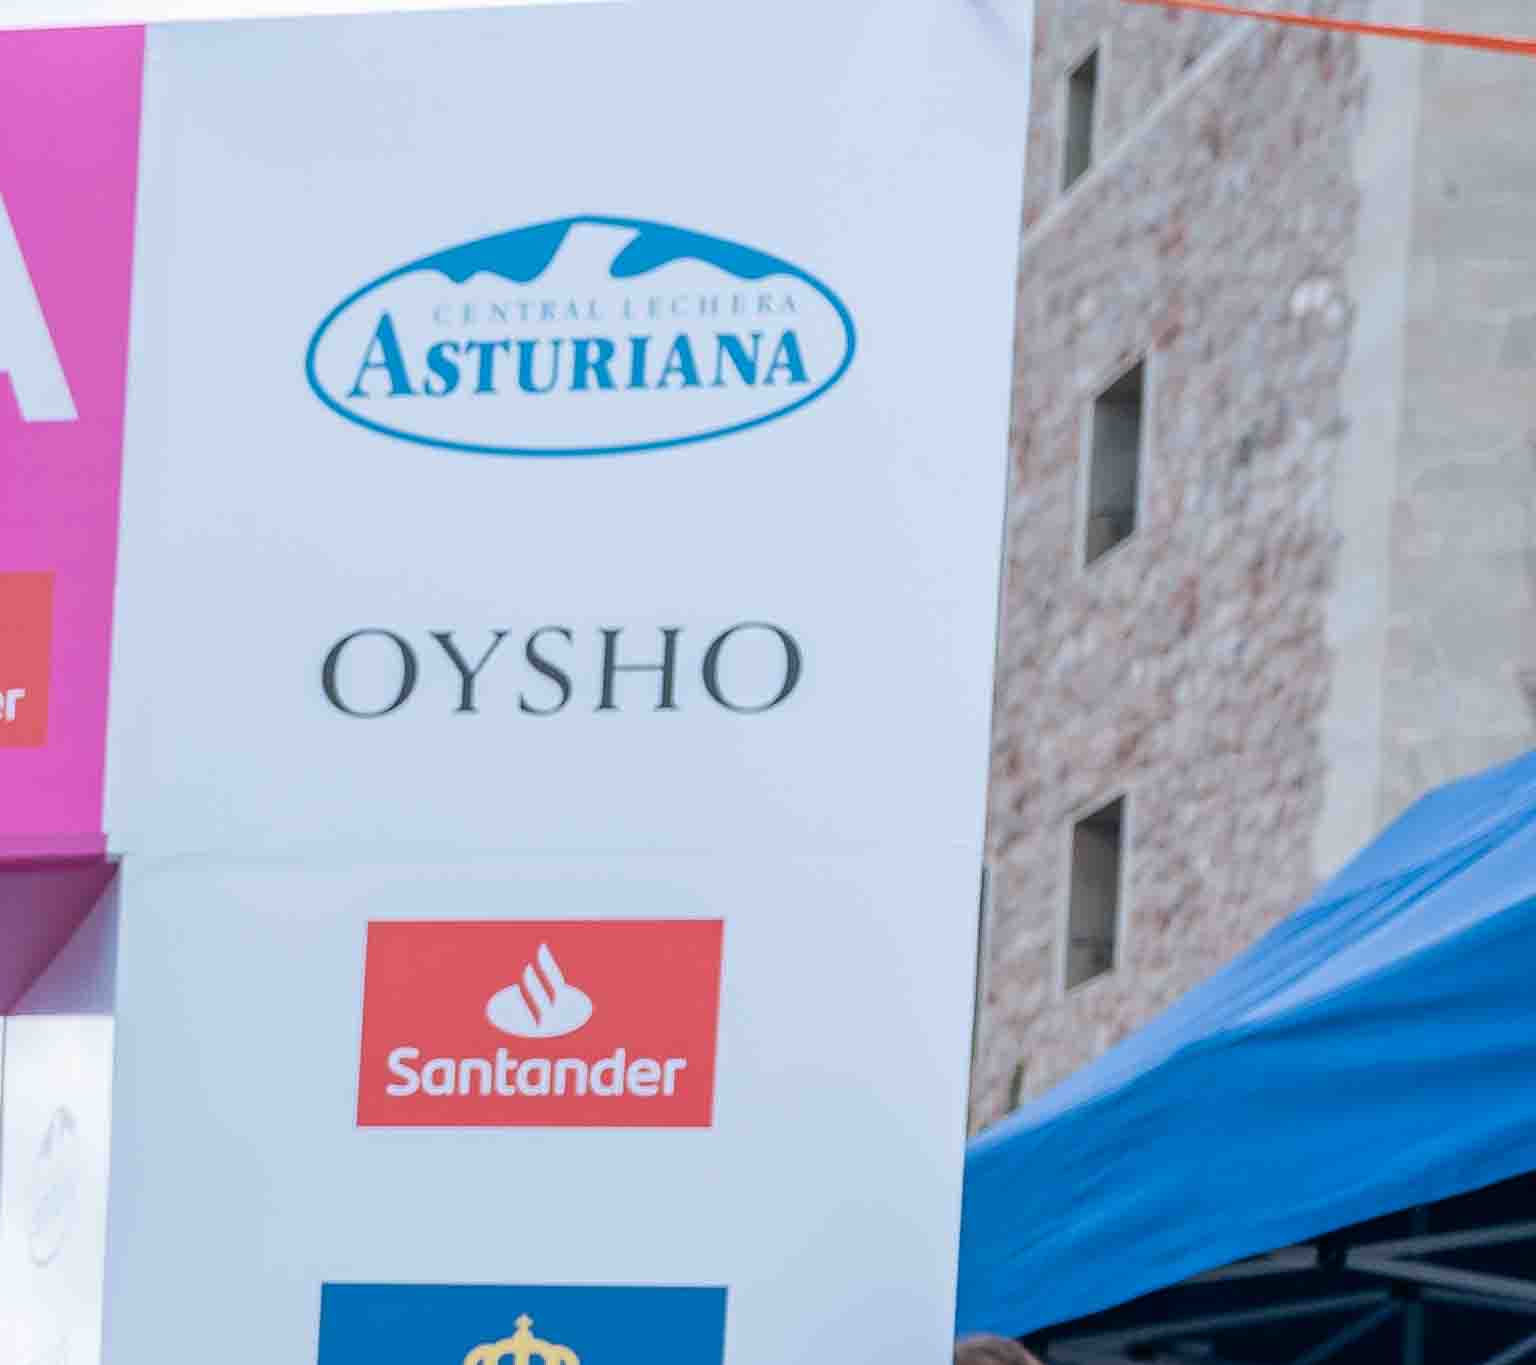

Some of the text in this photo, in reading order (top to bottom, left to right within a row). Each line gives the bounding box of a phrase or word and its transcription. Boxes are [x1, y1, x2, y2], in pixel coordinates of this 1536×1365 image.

[433, 292, 798, 327] CENTRAL LECHERA
[346, 312, 811, 403] ASTURIANA
[321, 621, 803, 719] OYSHO
[386, 1046, 687, 1098] Santander
